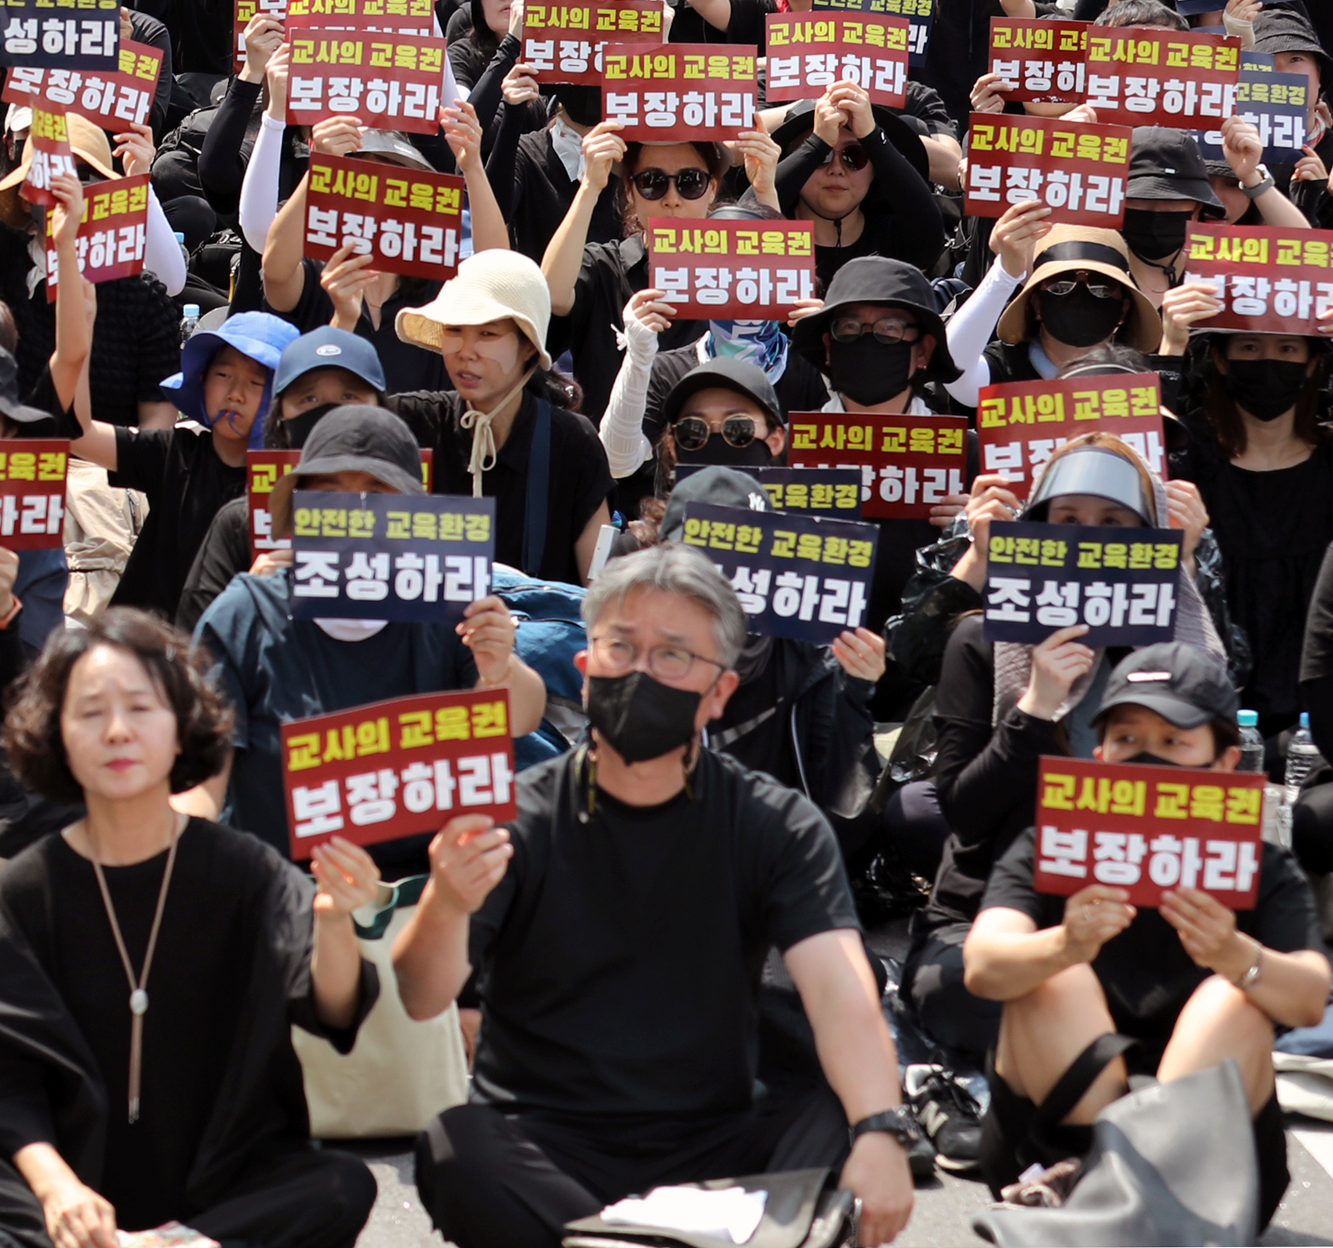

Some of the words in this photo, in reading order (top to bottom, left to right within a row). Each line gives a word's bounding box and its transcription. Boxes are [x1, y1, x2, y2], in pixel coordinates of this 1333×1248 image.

[292, 40, 363, 64] 교사의
[370, 43, 442, 72] 교육권
[290, 77, 439, 120] 보장하라
[972, 125, 1044, 154] 교사의
[1051, 132, 1128, 163] 교육권
[969, 165, 1124, 217] 보장하라
[654, 229, 728, 254] 교사의
[736, 231, 811, 255] 교육권
[653, 267, 815, 306] 보장하라
[295, 508, 376, 537] 안전한
[386, 511, 490, 541] 교육환경
[990, 537, 1067, 566] 안전한
[1077, 543, 1179, 569] 교육환경
[294, 551, 492, 604] 조성하라
[987, 577, 1175, 630] 조성하라
[288, 718, 390, 771] 교사의
[399, 702, 507, 748] 교육권
[293, 753, 517, 842] 보장하라
[1042, 774, 1146, 816] 교사의
[1155, 783, 1261, 824] 교육권
[1040, 826, 1258, 894] 보장하라
